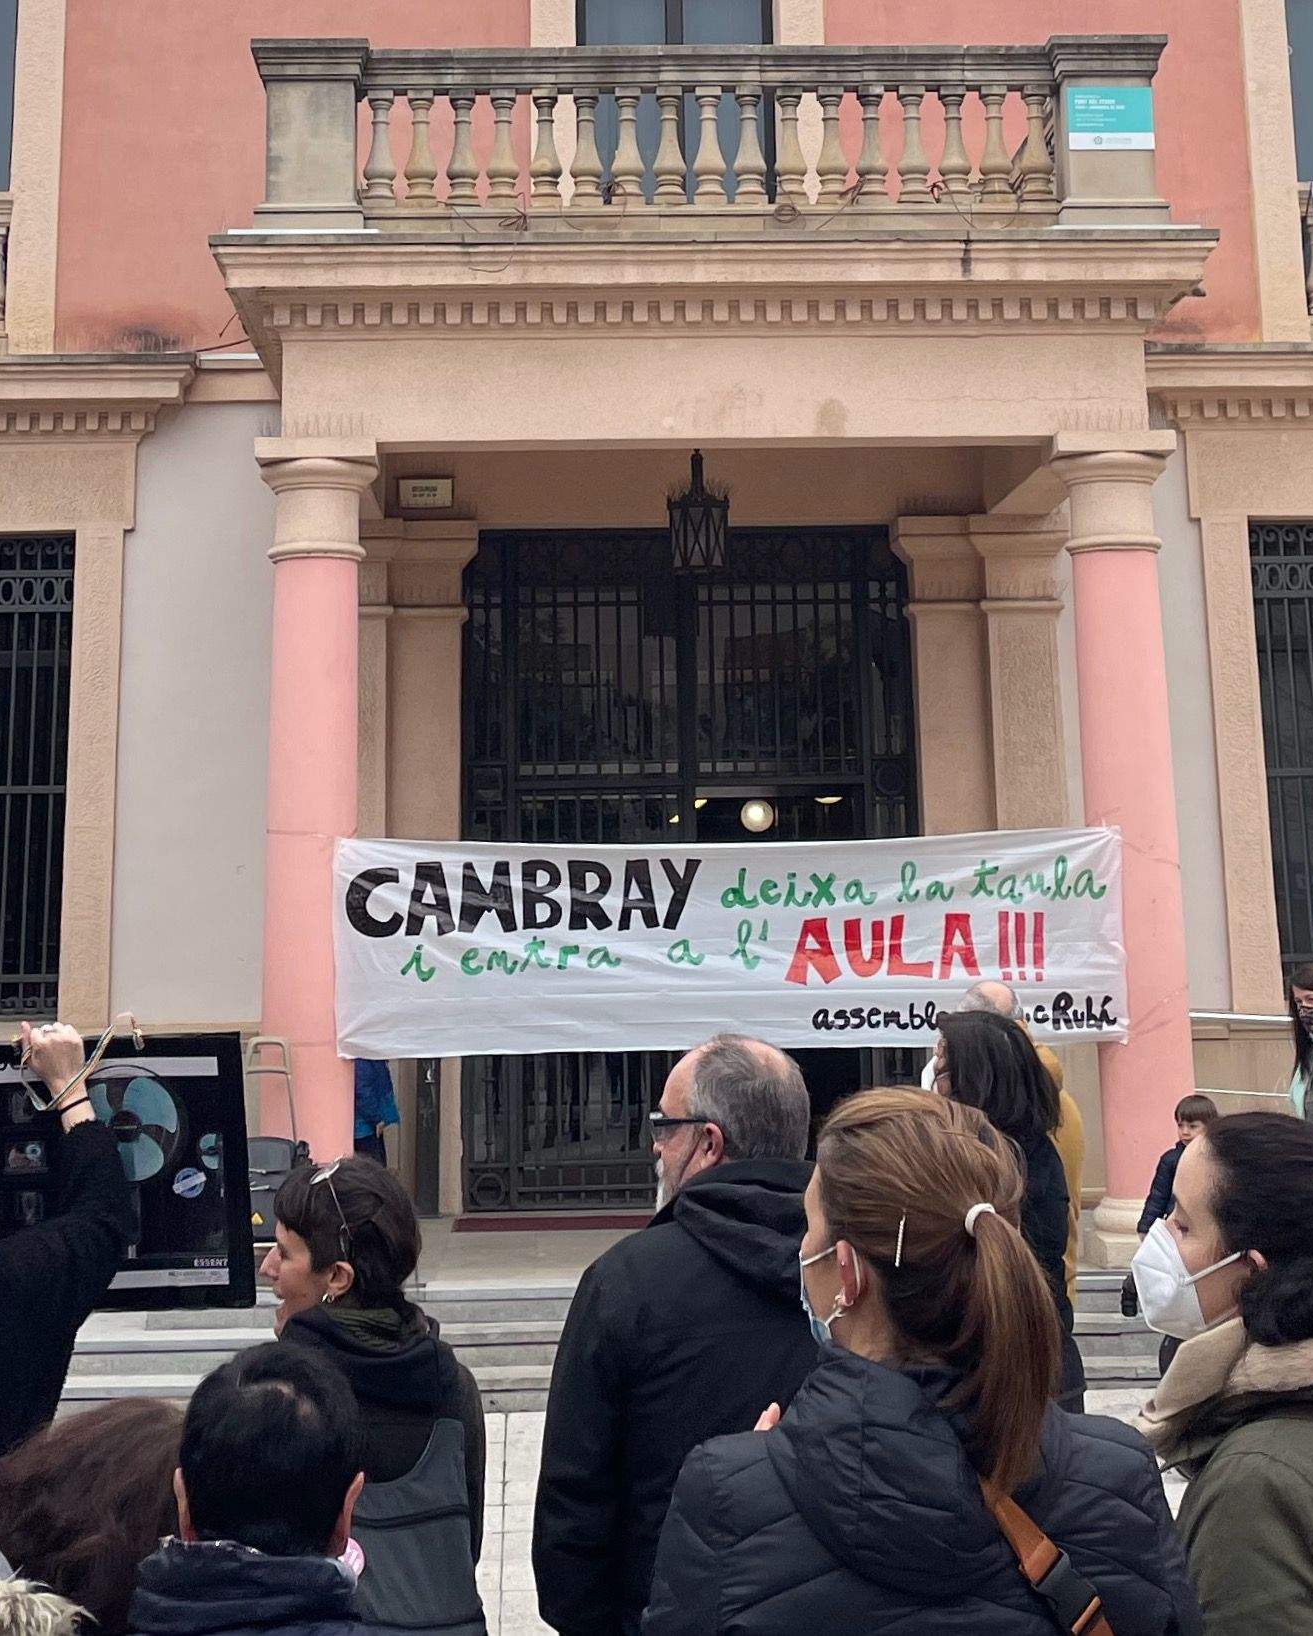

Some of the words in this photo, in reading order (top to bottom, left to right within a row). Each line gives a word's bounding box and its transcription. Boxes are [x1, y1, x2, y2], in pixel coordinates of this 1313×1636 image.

[345, 858, 702, 938] CAMBRAY
[721, 867, 878, 908] deixa
[897, 861, 955, 903] la
[970, 855, 1107, 904] taula
[400, 944, 436, 982] i
[460, 935, 622, 977] entra
[666, 938, 705, 966] a
[812, 1001, 939, 1030] assembl
